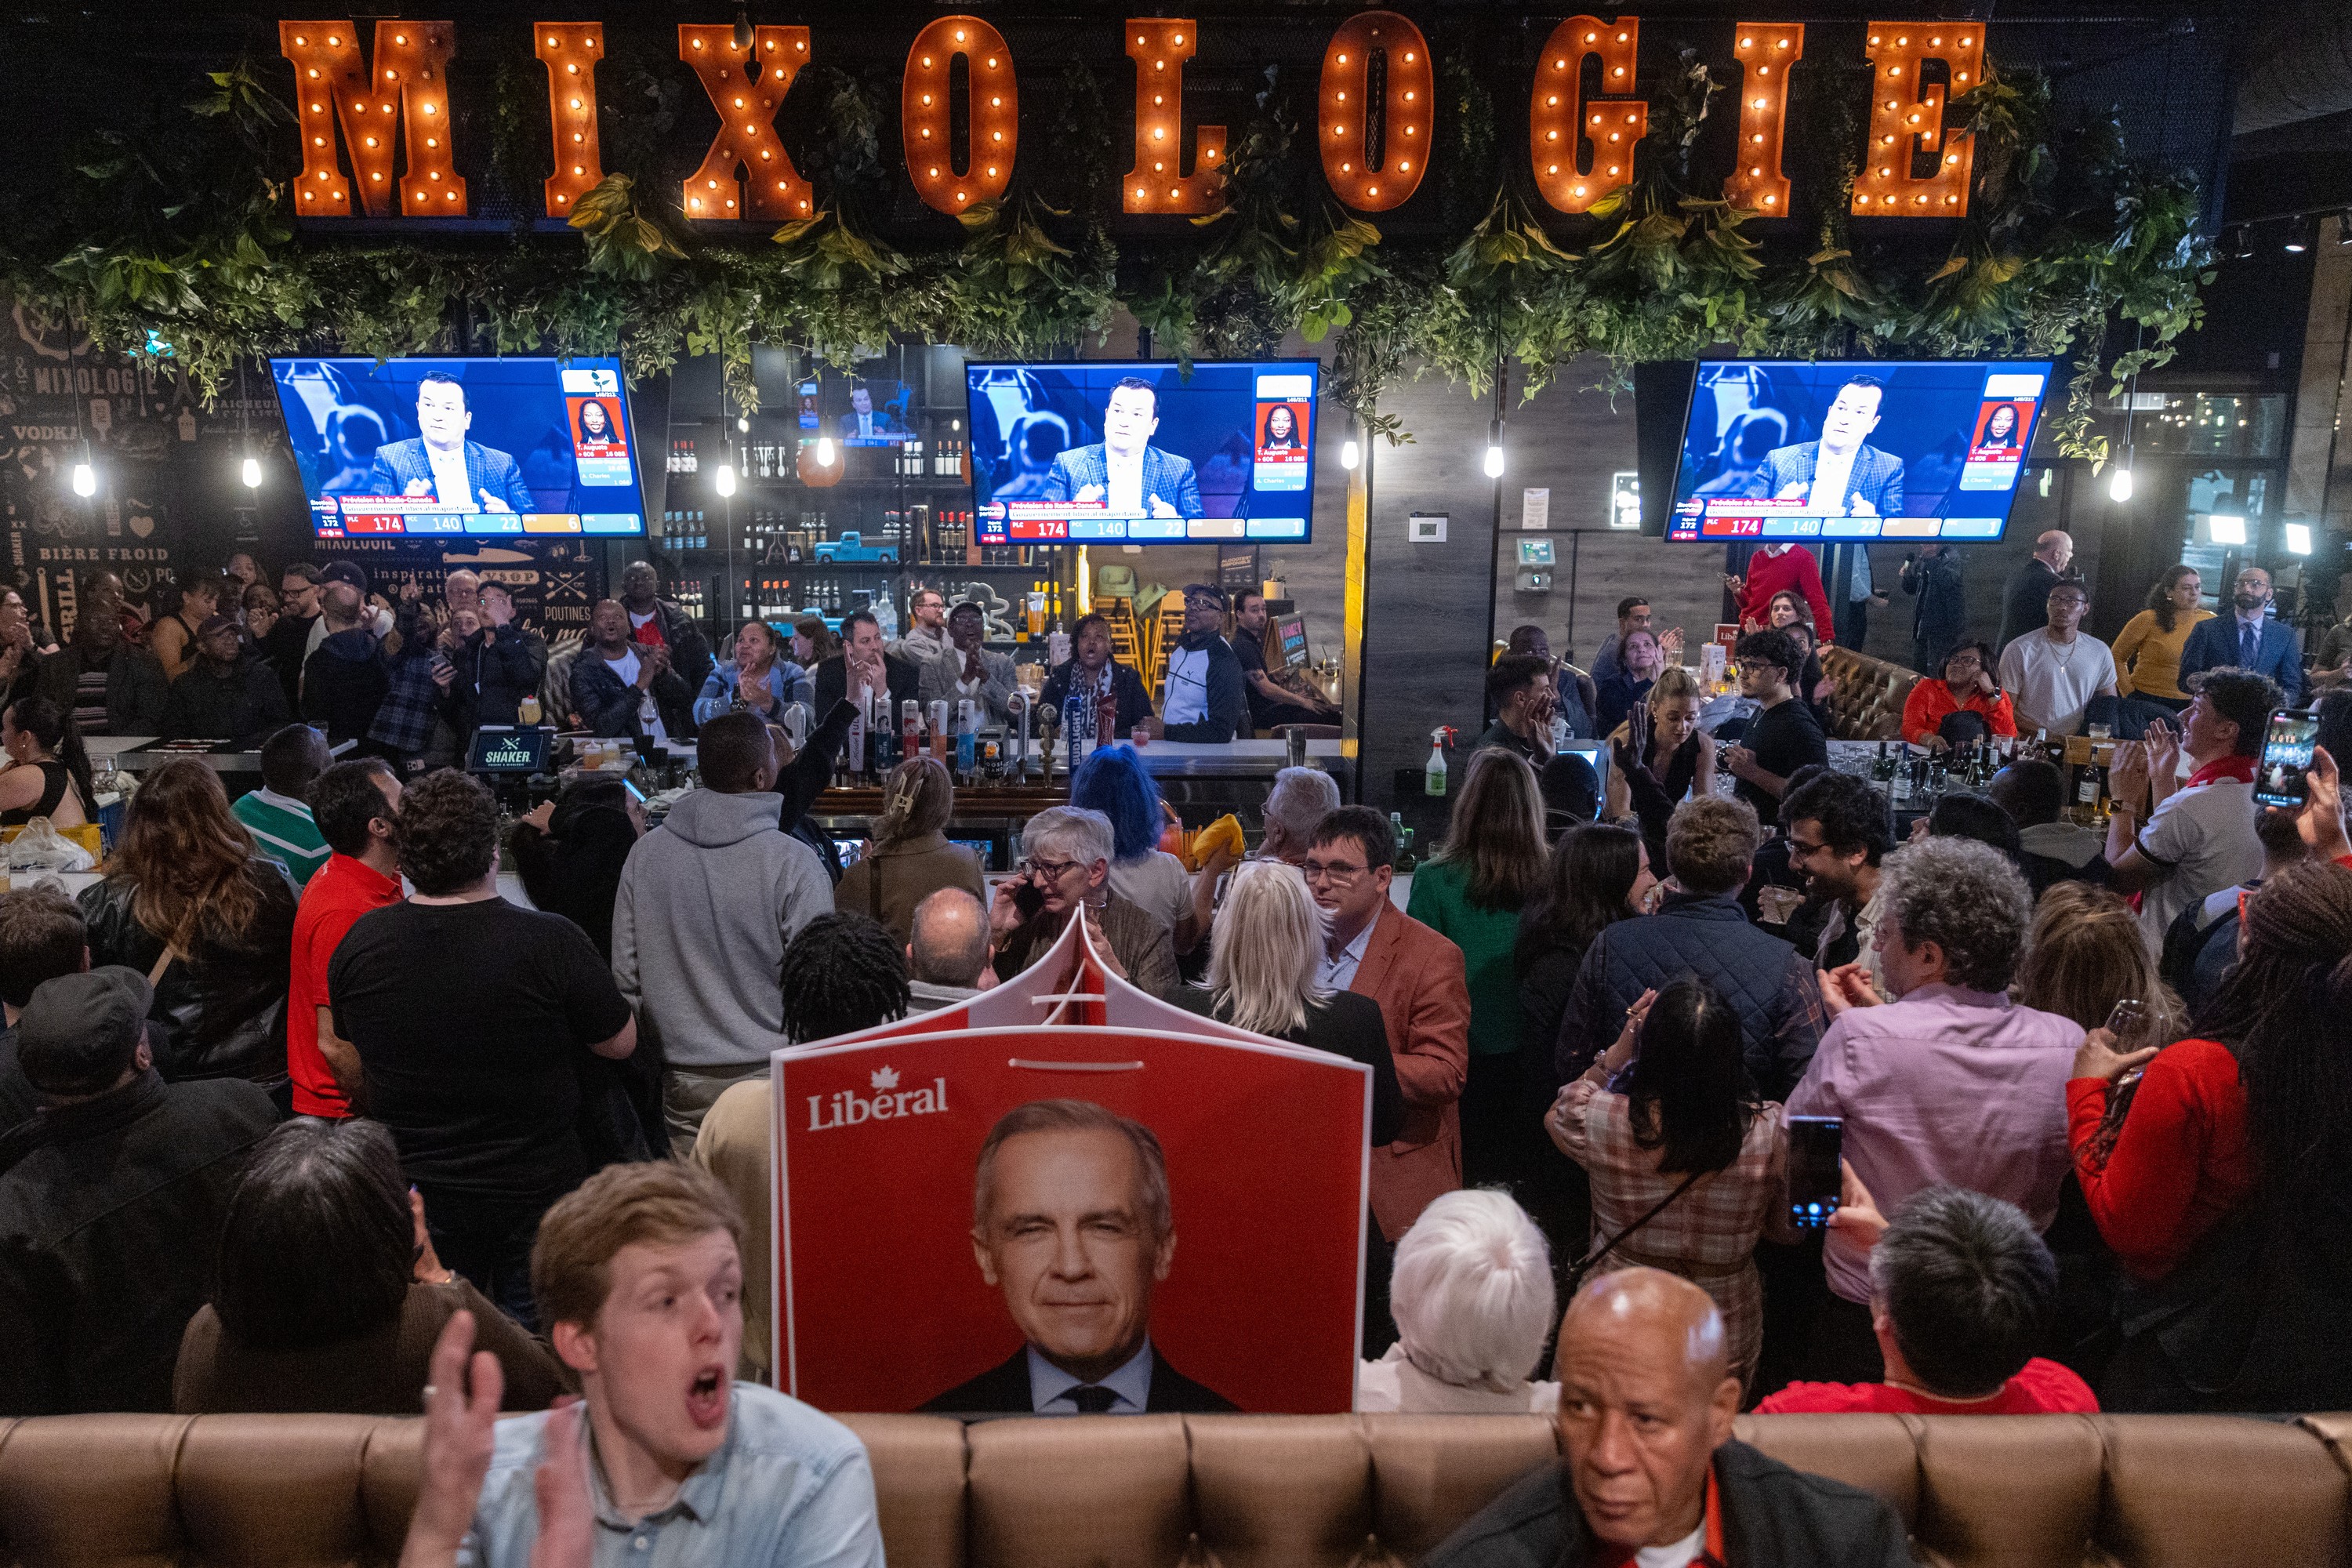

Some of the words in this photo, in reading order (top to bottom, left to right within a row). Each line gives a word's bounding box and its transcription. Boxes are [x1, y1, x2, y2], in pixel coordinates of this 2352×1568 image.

[278, 11, 1986, 220] MIXOLOGIE
[373, 517, 401, 530] 174
[433, 517, 459, 530] 140
[500, 517, 519, 530] 22
[568, 517, 578, 530] 6
[627, 517, 637, 529] 1
[1038, 522, 1065, 536] 174
[1098, 522, 1123, 535] 140
[1165, 522, 1182, 535] 22
[1232, 522, 1242, 535] 6
[1292, 521, 1301, 535] 1
[1731, 520, 1758, 533] 174
[1791, 521, 1819, 533] 140
[1859, 521, 1878, 534] 22
[1927, 521, 1939, 534] 6
[1987, 521, 1996, 534] 1
[39, 544, 100, 561] BIÈRE
[107, 547, 169, 561] FROID
[484, 572, 535, 582] VSOP
[544, 605, 591, 622] POUTINES
[1072, 710, 1081, 738] LIGHT
[485, 751, 530, 763] SHAKER
[1072, 743, 1081, 766] BUD
